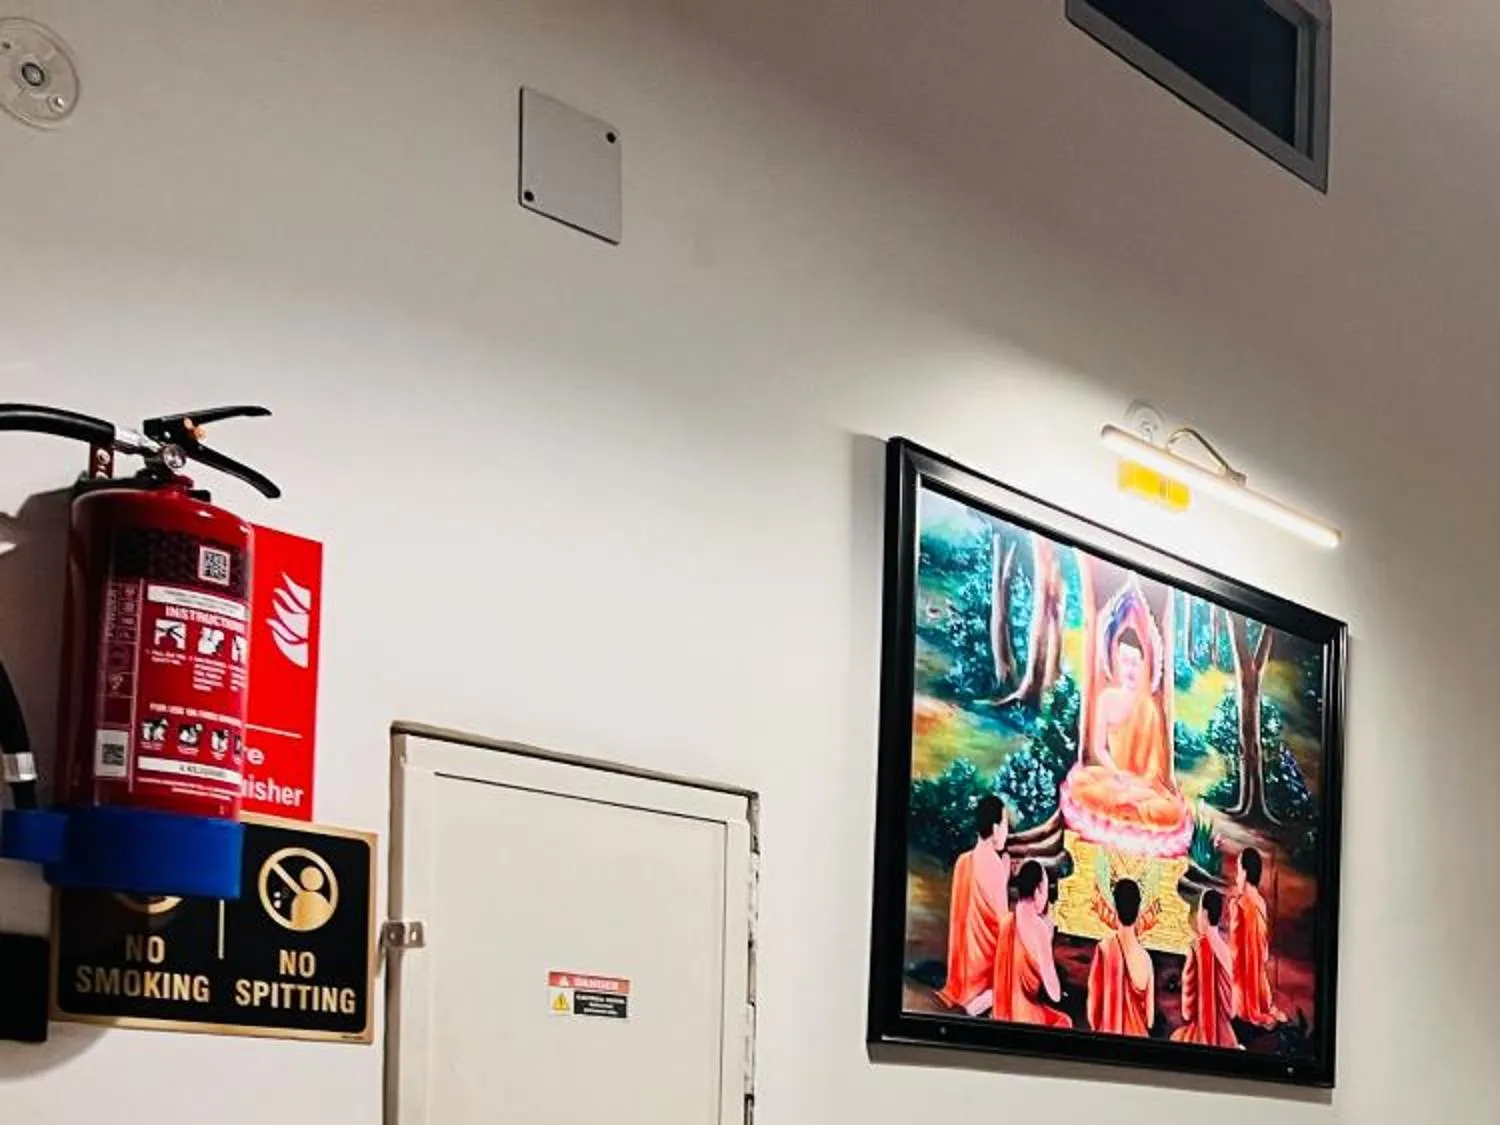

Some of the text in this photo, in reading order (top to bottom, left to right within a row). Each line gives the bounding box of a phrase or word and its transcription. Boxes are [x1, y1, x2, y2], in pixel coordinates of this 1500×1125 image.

[125, 934, 165, 964] NO
[279, 949, 316, 978] NO
[76, 965, 210, 1003] SMOKING
[235, 979, 356, 1014] SPITTING
